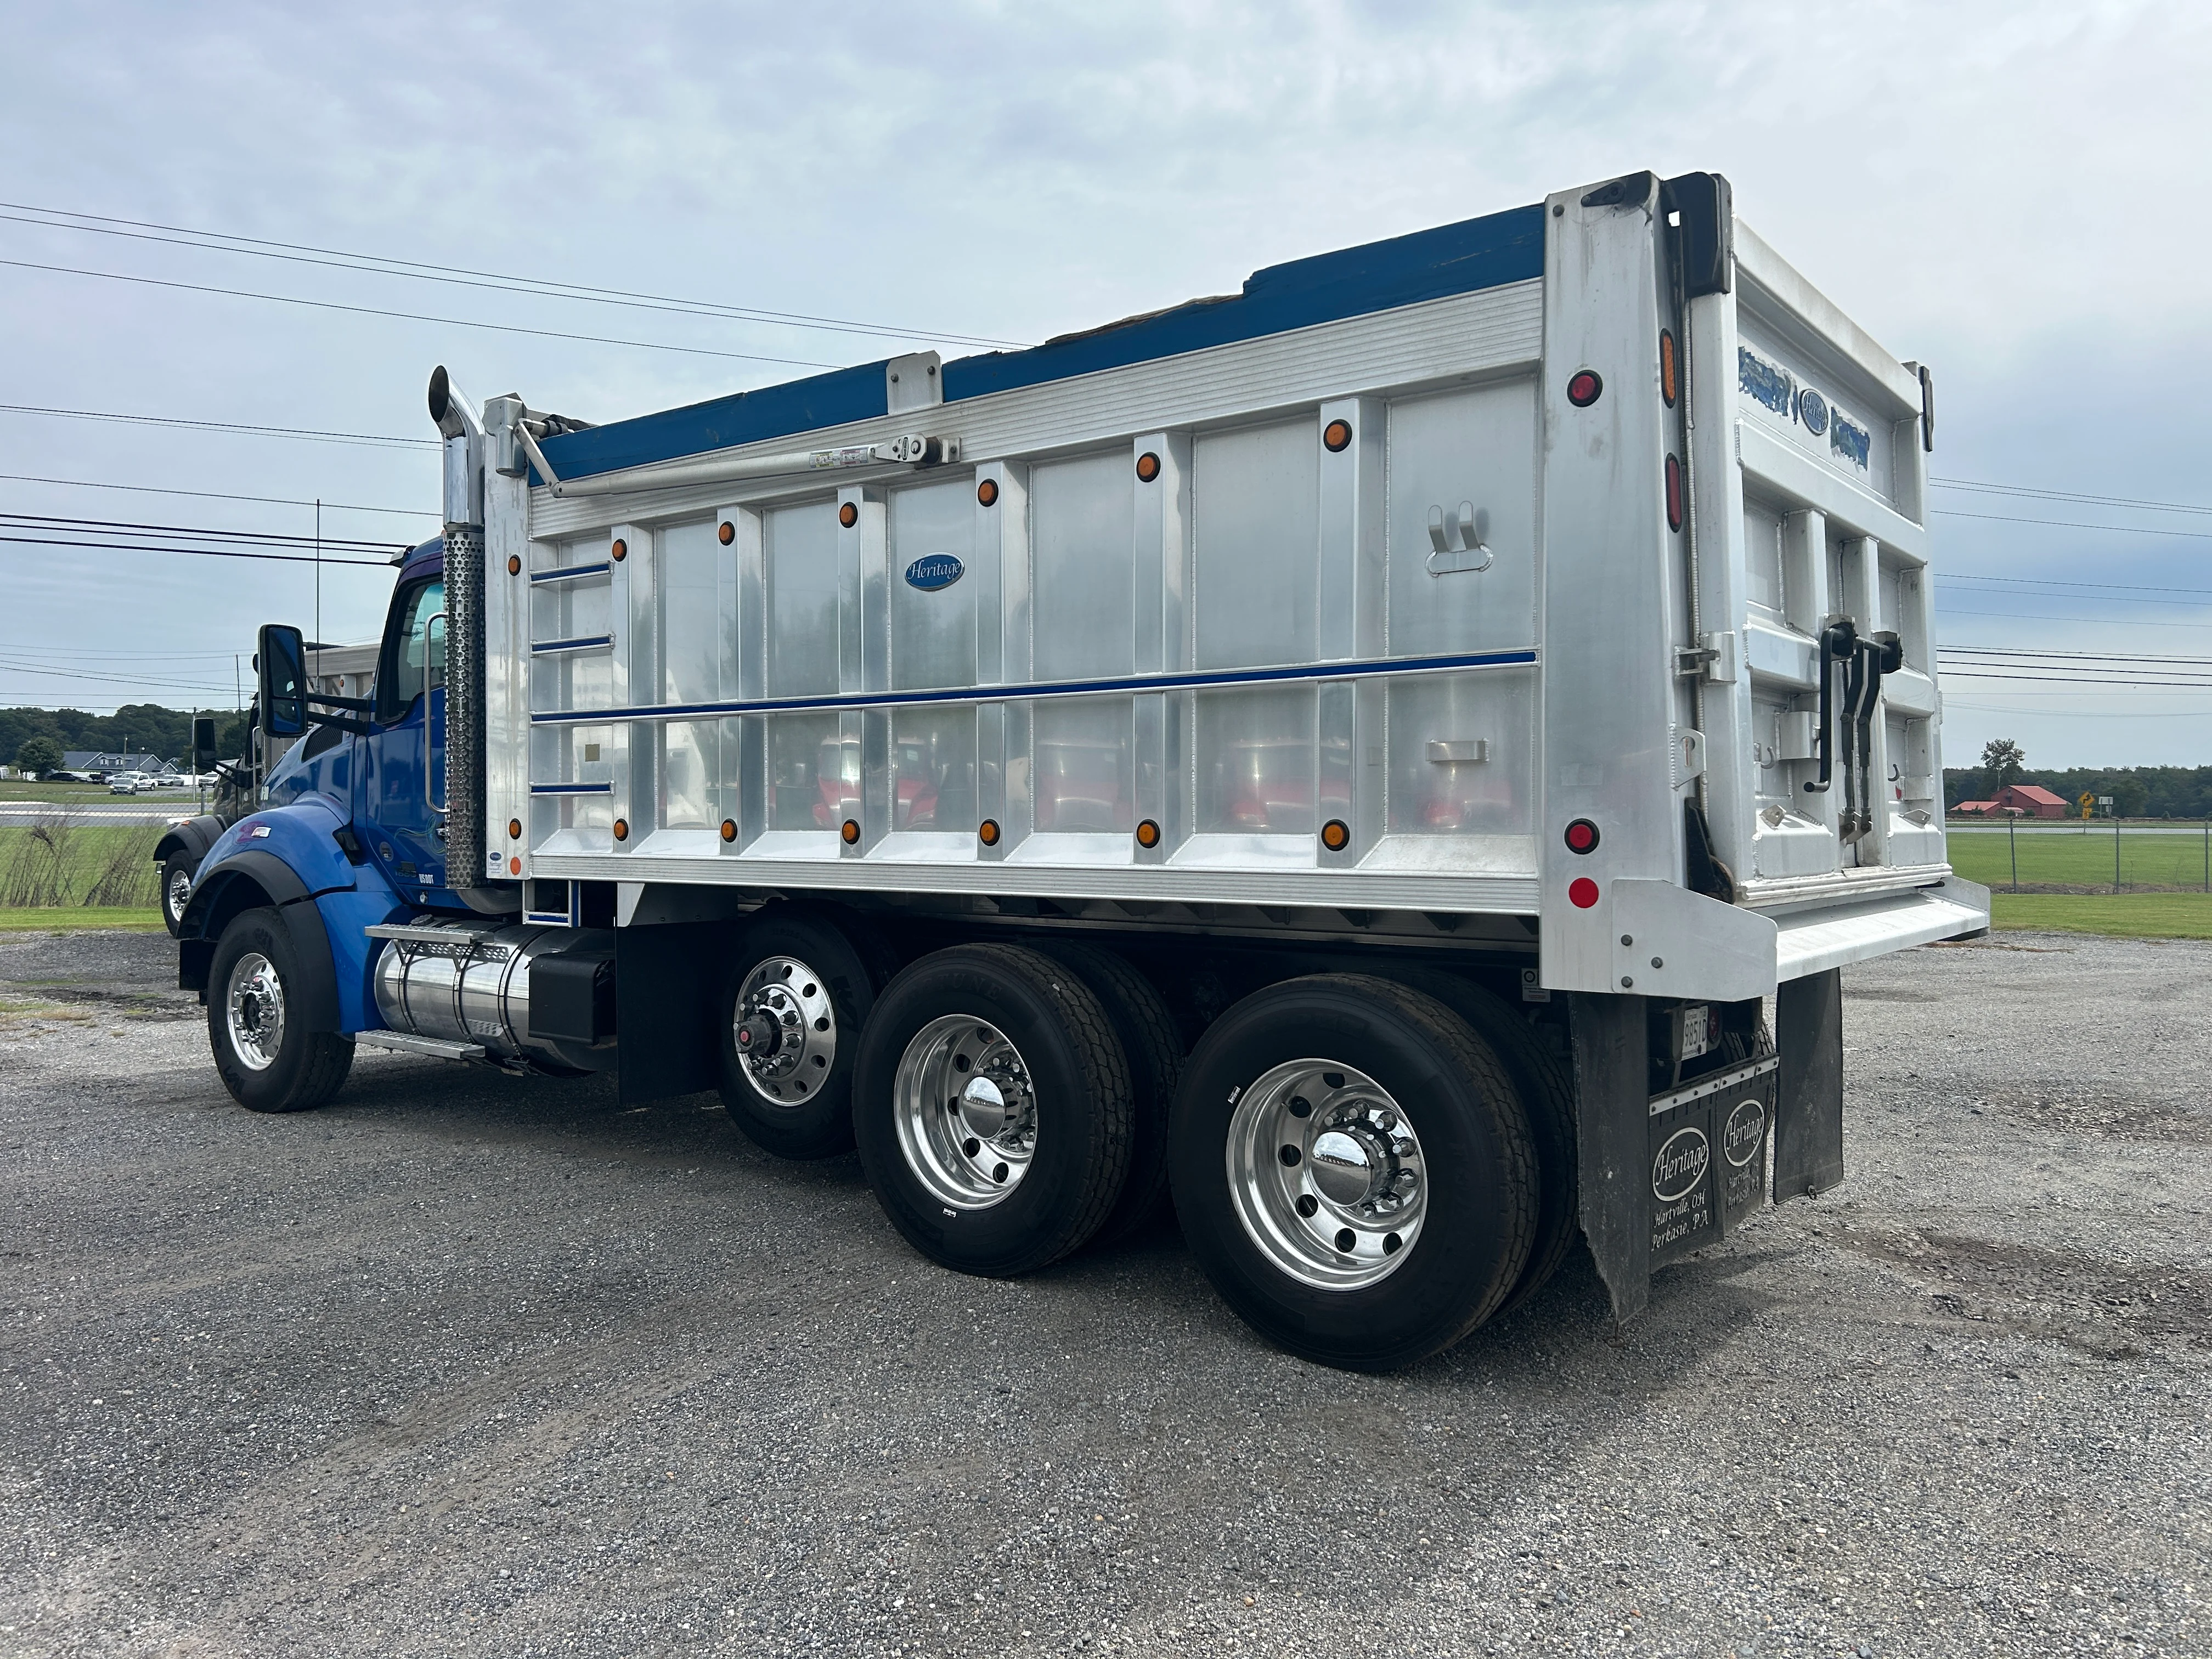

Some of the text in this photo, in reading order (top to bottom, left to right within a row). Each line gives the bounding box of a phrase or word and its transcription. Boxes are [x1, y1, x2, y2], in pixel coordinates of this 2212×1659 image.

[907, 560, 961, 580] Heritage
[1726, 1114, 1763, 1150] Heritage
[1656, 1144, 1706, 1186] Heritage
[1654, 1188, 1707, 1228] Hartville, OH
[1651, 1210, 1709, 1251] Perkasie, PA
